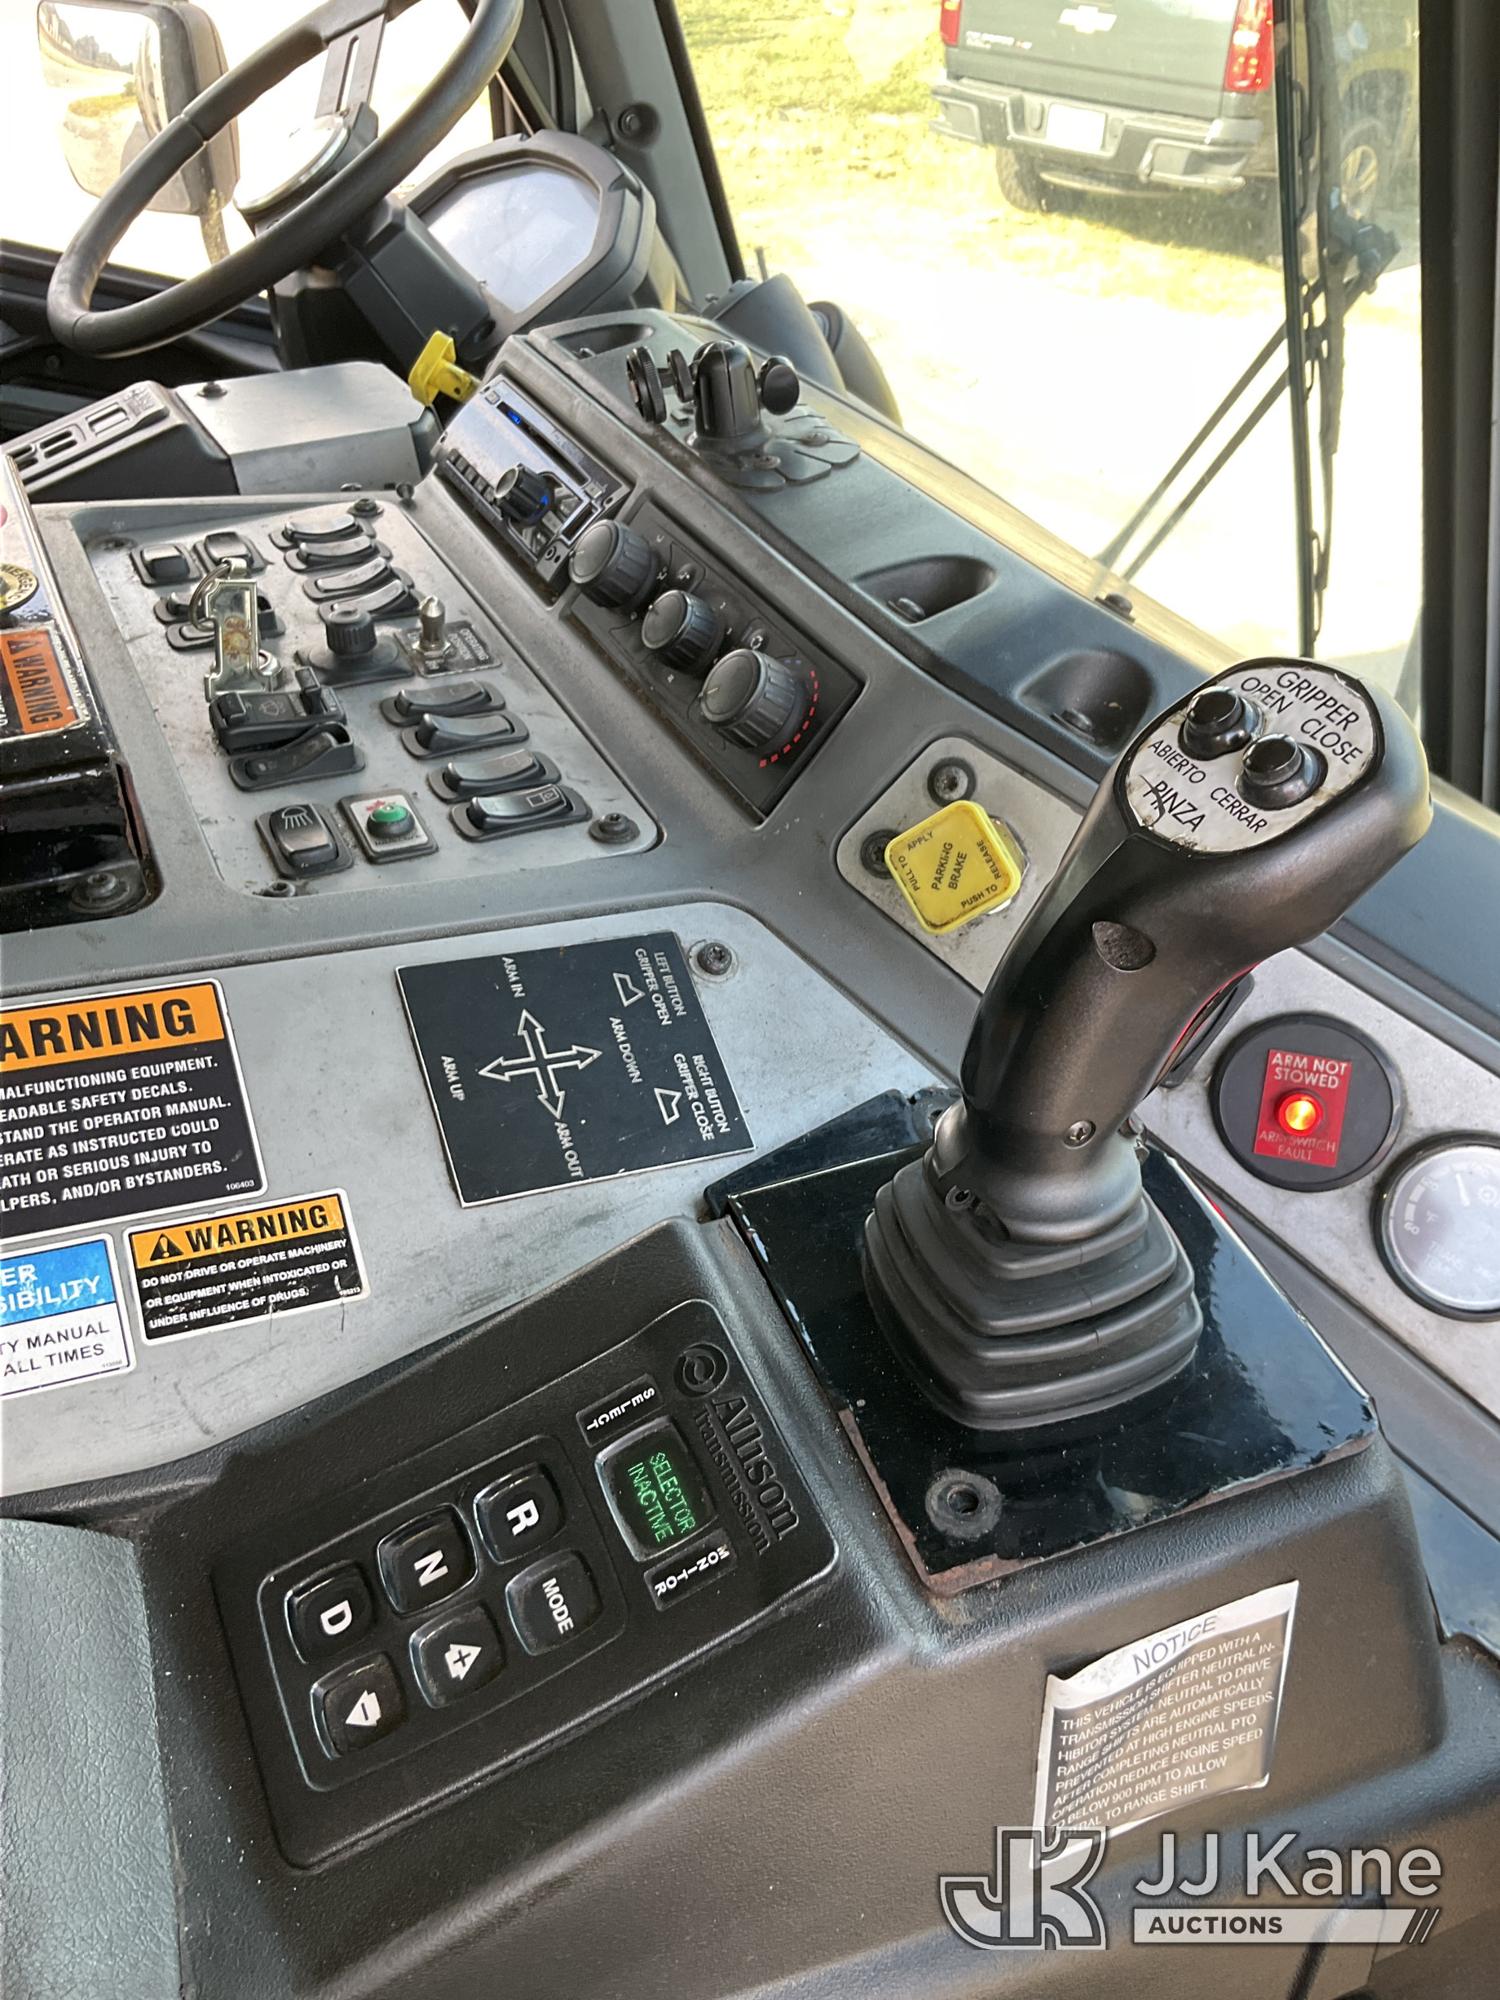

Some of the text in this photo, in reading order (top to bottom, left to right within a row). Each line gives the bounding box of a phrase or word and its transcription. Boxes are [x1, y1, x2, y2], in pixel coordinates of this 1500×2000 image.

[13, 653, 63, 725] WARNING
[1240, 676, 1294, 715] OPEN
[1276, 671, 1360, 731] GRIPPER
[1148, 739, 1206, 784] ABIERTO
[1300, 718, 1363, 765] CLOSE
[1143, 780, 1206, 832] PINZA
[1210, 787, 1268, 833] CERRAR
[907, 831, 935, 851] APPLY
[976, 839, 1002, 880] RELEASE
[898, 855, 920, 891] PULL TO
[932, 842, 953, 890] PARKING
[948, 851, 967, 890] BRAKE
[960, 884, 998, 909] PUSH TO
[502, 956, 526, 998] ARM IN
[635, 948, 673, 1026] GRIPPER OPEN
[654, 951, 687, 1017] LEFT BUTTON
[0, 998, 196, 1062] ARNING
[609, 1016, 643, 1083] ARM DOWN
[131, 1056, 219, 1080] EQUIPMENT.
[441, 1055, 466, 1102] ARM UP
[1272, 1053, 1347, 1075] ARM NOT
[1274, 1067, 1340, 1089] STOWED
[48, 1119, 79, 1136] THE
[82, 1107, 162, 1131] OPERATOR
[166, 1095, 232, 1117] MANUAL.
[71, 1090, 127, 1111] SAFETY
[131, 1081, 193, 1101] DECALS.
[673, 1053, 715, 1141] GRIPPER CLOSE
[692, 1054, 731, 1133] RIGHT BUTTON
[48, 1143, 69, 1159] AS
[72, 1127, 167, 1154] INSTRUCTED
[171, 1117, 220, 1137] COULD
[554, 1121, 584, 1177] ARM OUT
[0, 1140, 212, 1189] ATH OR SERIOUS INJURY TO
[62, 1179, 121, 1201] AND/OR
[126, 1160, 228, 1190] BYSTANDERS.
[186, 1204, 329, 1253] WARNING
[142, 1238, 347, 1289] DO NOT DRIVE OR OPERATE MACHINERY
[146, 1259, 348, 1309] OR EQUIPMENT WHEN INTOXICATED OR
[27, 1321, 110, 1350] MANUAL
[148, 1313, 188, 1329] UNDER
[189, 1300, 250, 1321] INFLUENCE
[251, 1296, 267, 1307] OF
[4, 1357, 42, 1376] ALL
[45, 1343, 105, 1367] TIMES
[587, 1387, 655, 1431] SELECT
[627, 1461, 674, 1542] INACTIVE
[649, 1451, 697, 1534] SELECTOR
[506, 1499, 540, 1536] R
[413, 1549, 449, 1587] N
[654, 1543, 731, 1597] MONITOR
[320, 1600, 352, 1635] D
[541, 1577, 574, 1635] MODE
[1132, 1614, 1218, 1676] NOTICE
[1060, 1642, 1275, 1746] TRANSMISSION SHIFTER NEUTRAL IN-
[1061, 1631, 1261, 1731] THIS VEHICLE IS EQUIPPED WITH A
[1057, 1676, 1265, 1777] RANGE SHIFTS ARE AUTOMATICALLY
[1058, 1733, 1107, 1761] HIBITOR
[1158, 1680, 1213, 1708] NEUTRAL
[1216, 1671, 1233, 1686] TO
[1235, 1657, 1272, 1678] DRIVE
[1053, 1713, 1257, 1807] AFTER COMPLETING NEUTRAL PTO
[1056, 1747, 1124, 1792] PREVENTED
[1125, 1738, 1141, 1753] AT
[1143, 1725, 1173, 1746] HIGH
[1175, 1706, 1221, 1733] ENGINE
[1052, 1727, 1264, 1820] OPERATION REDUCE ENGINE SPEED
[1067, 1795, 1110, 1824] BELOW
[1112, 1787, 1132, 1804] 900
[1134, 1774, 1161, 1794] RPM
[1164, 1767, 1181, 1782] TO
[1184, 1755, 1228, 1778] ALLOW
[1105, 1806, 1121, 1821] TO
[1123, 1788, 1167, 1814] RANGE
